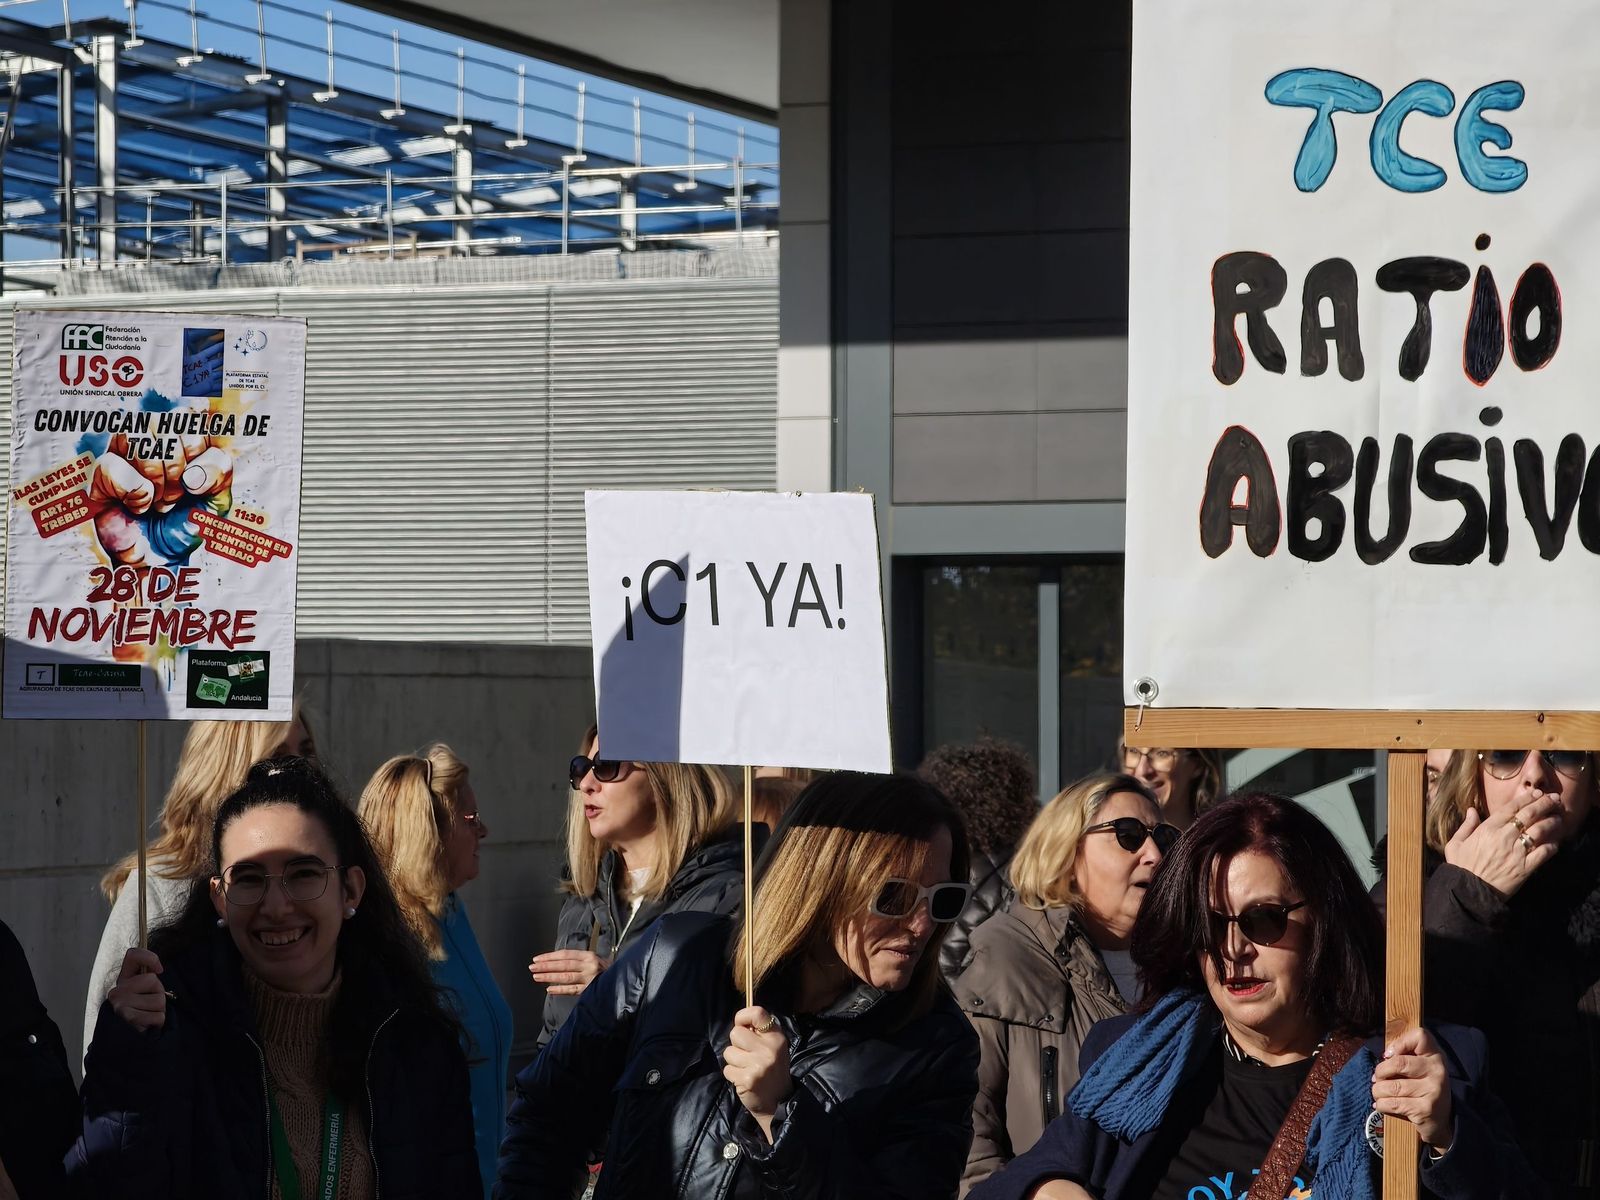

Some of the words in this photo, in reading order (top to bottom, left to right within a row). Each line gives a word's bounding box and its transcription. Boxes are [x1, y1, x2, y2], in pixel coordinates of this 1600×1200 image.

[1265, 67, 1528, 193] TCE
[105, 343, 141, 351] Ciudadanía
[59, 354, 144, 388] USO
[34, 409, 151, 434] CONVOCAN
[157, 412, 235, 435] HUELGA
[243, 414, 270, 437] DE
[127, 437, 177, 460] TCAE
[40, 464, 76, 487] LEYES
[76, 456, 92, 469] SE
[40, 503, 67, 520] ART.
[67, 495, 83, 508] 76
[41, 506, 89, 532] TREBEP
[234, 508, 264, 525] 11:30
[203, 526, 214, 538] EL
[216, 532, 254, 552] CENTRO
[255, 546, 269, 558] DE
[209, 540, 255, 563] TRABAJO
[273, 542, 288, 554] EN
[87, 566, 136, 603] 28
[147, 567, 201, 603] DE
[622, 559, 719, 641] ¡C1
[746, 561, 846, 630] YA!
[28, 607, 258, 650] NOVIEMBRE
[192, 658, 227, 667] Plataforma
[328, 1113, 340, 1173] ENFERMERÍA
